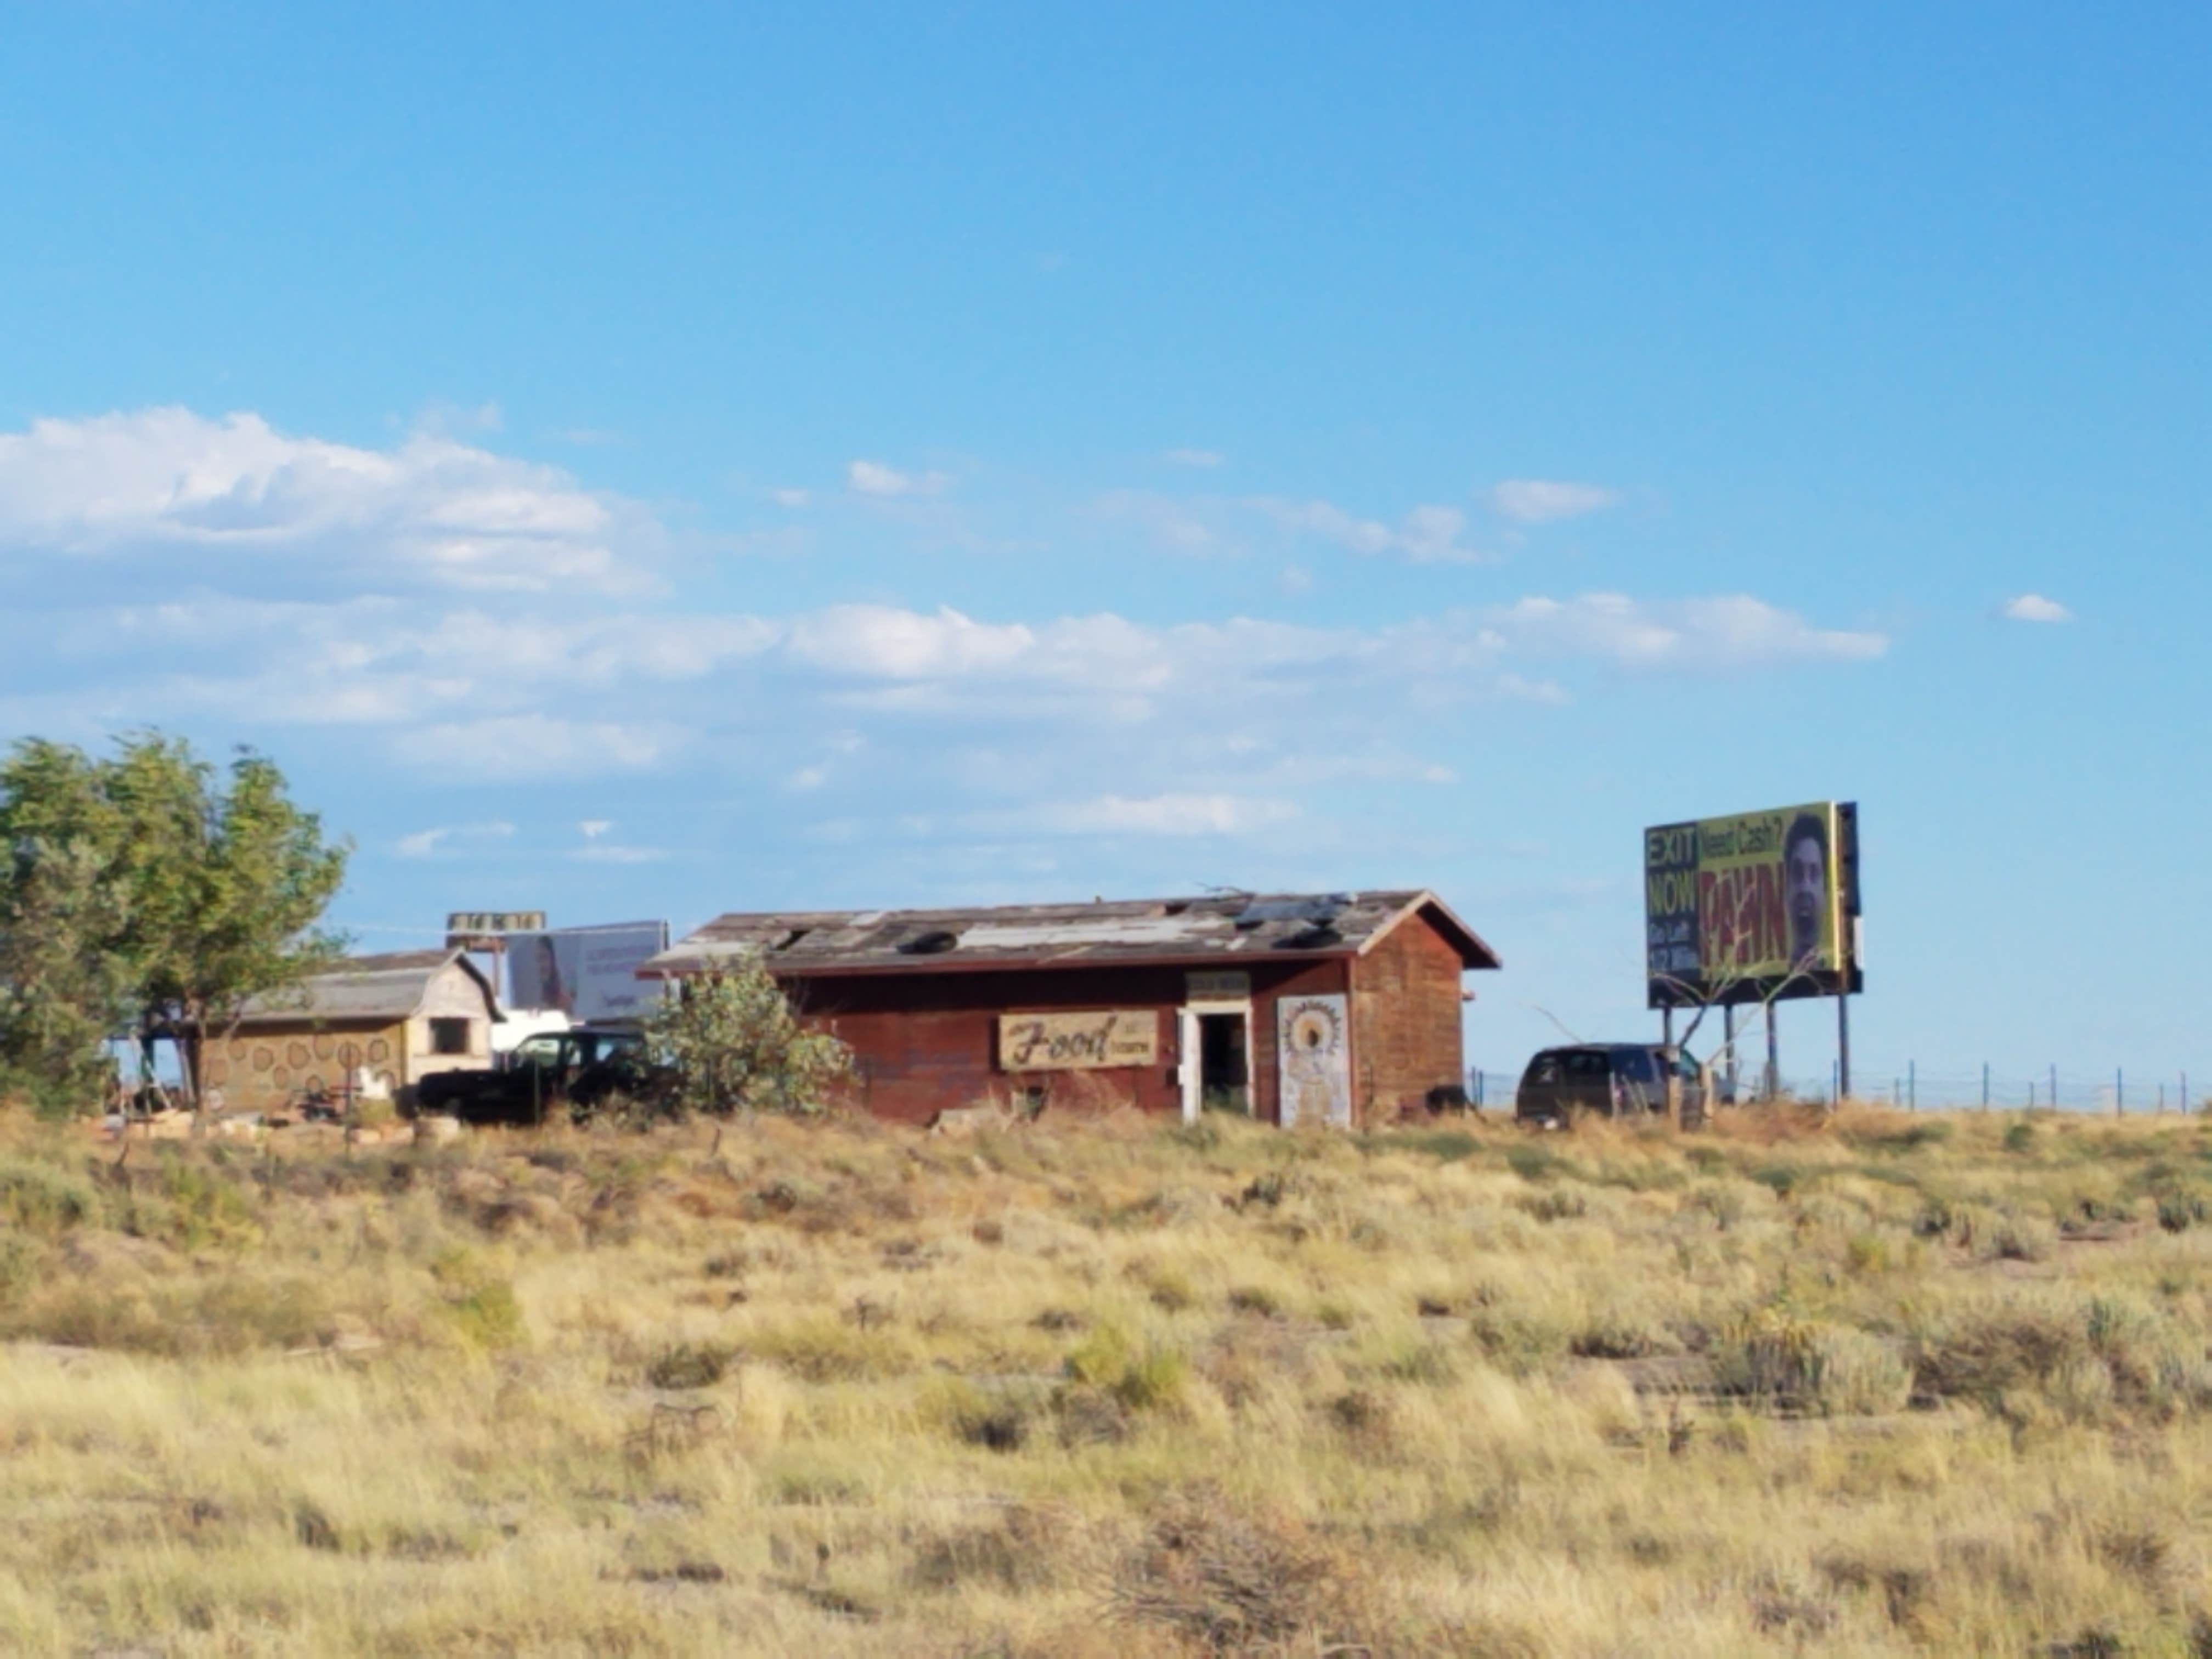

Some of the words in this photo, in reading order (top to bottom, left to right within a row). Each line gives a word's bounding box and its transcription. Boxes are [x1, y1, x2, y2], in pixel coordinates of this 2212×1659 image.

[1649, 828, 1694, 865] EXIT
[1738, 816, 1782, 854] Cash?
[1649, 871, 1694, 915] NOW
[1008, 1015, 1118, 1064] Food
